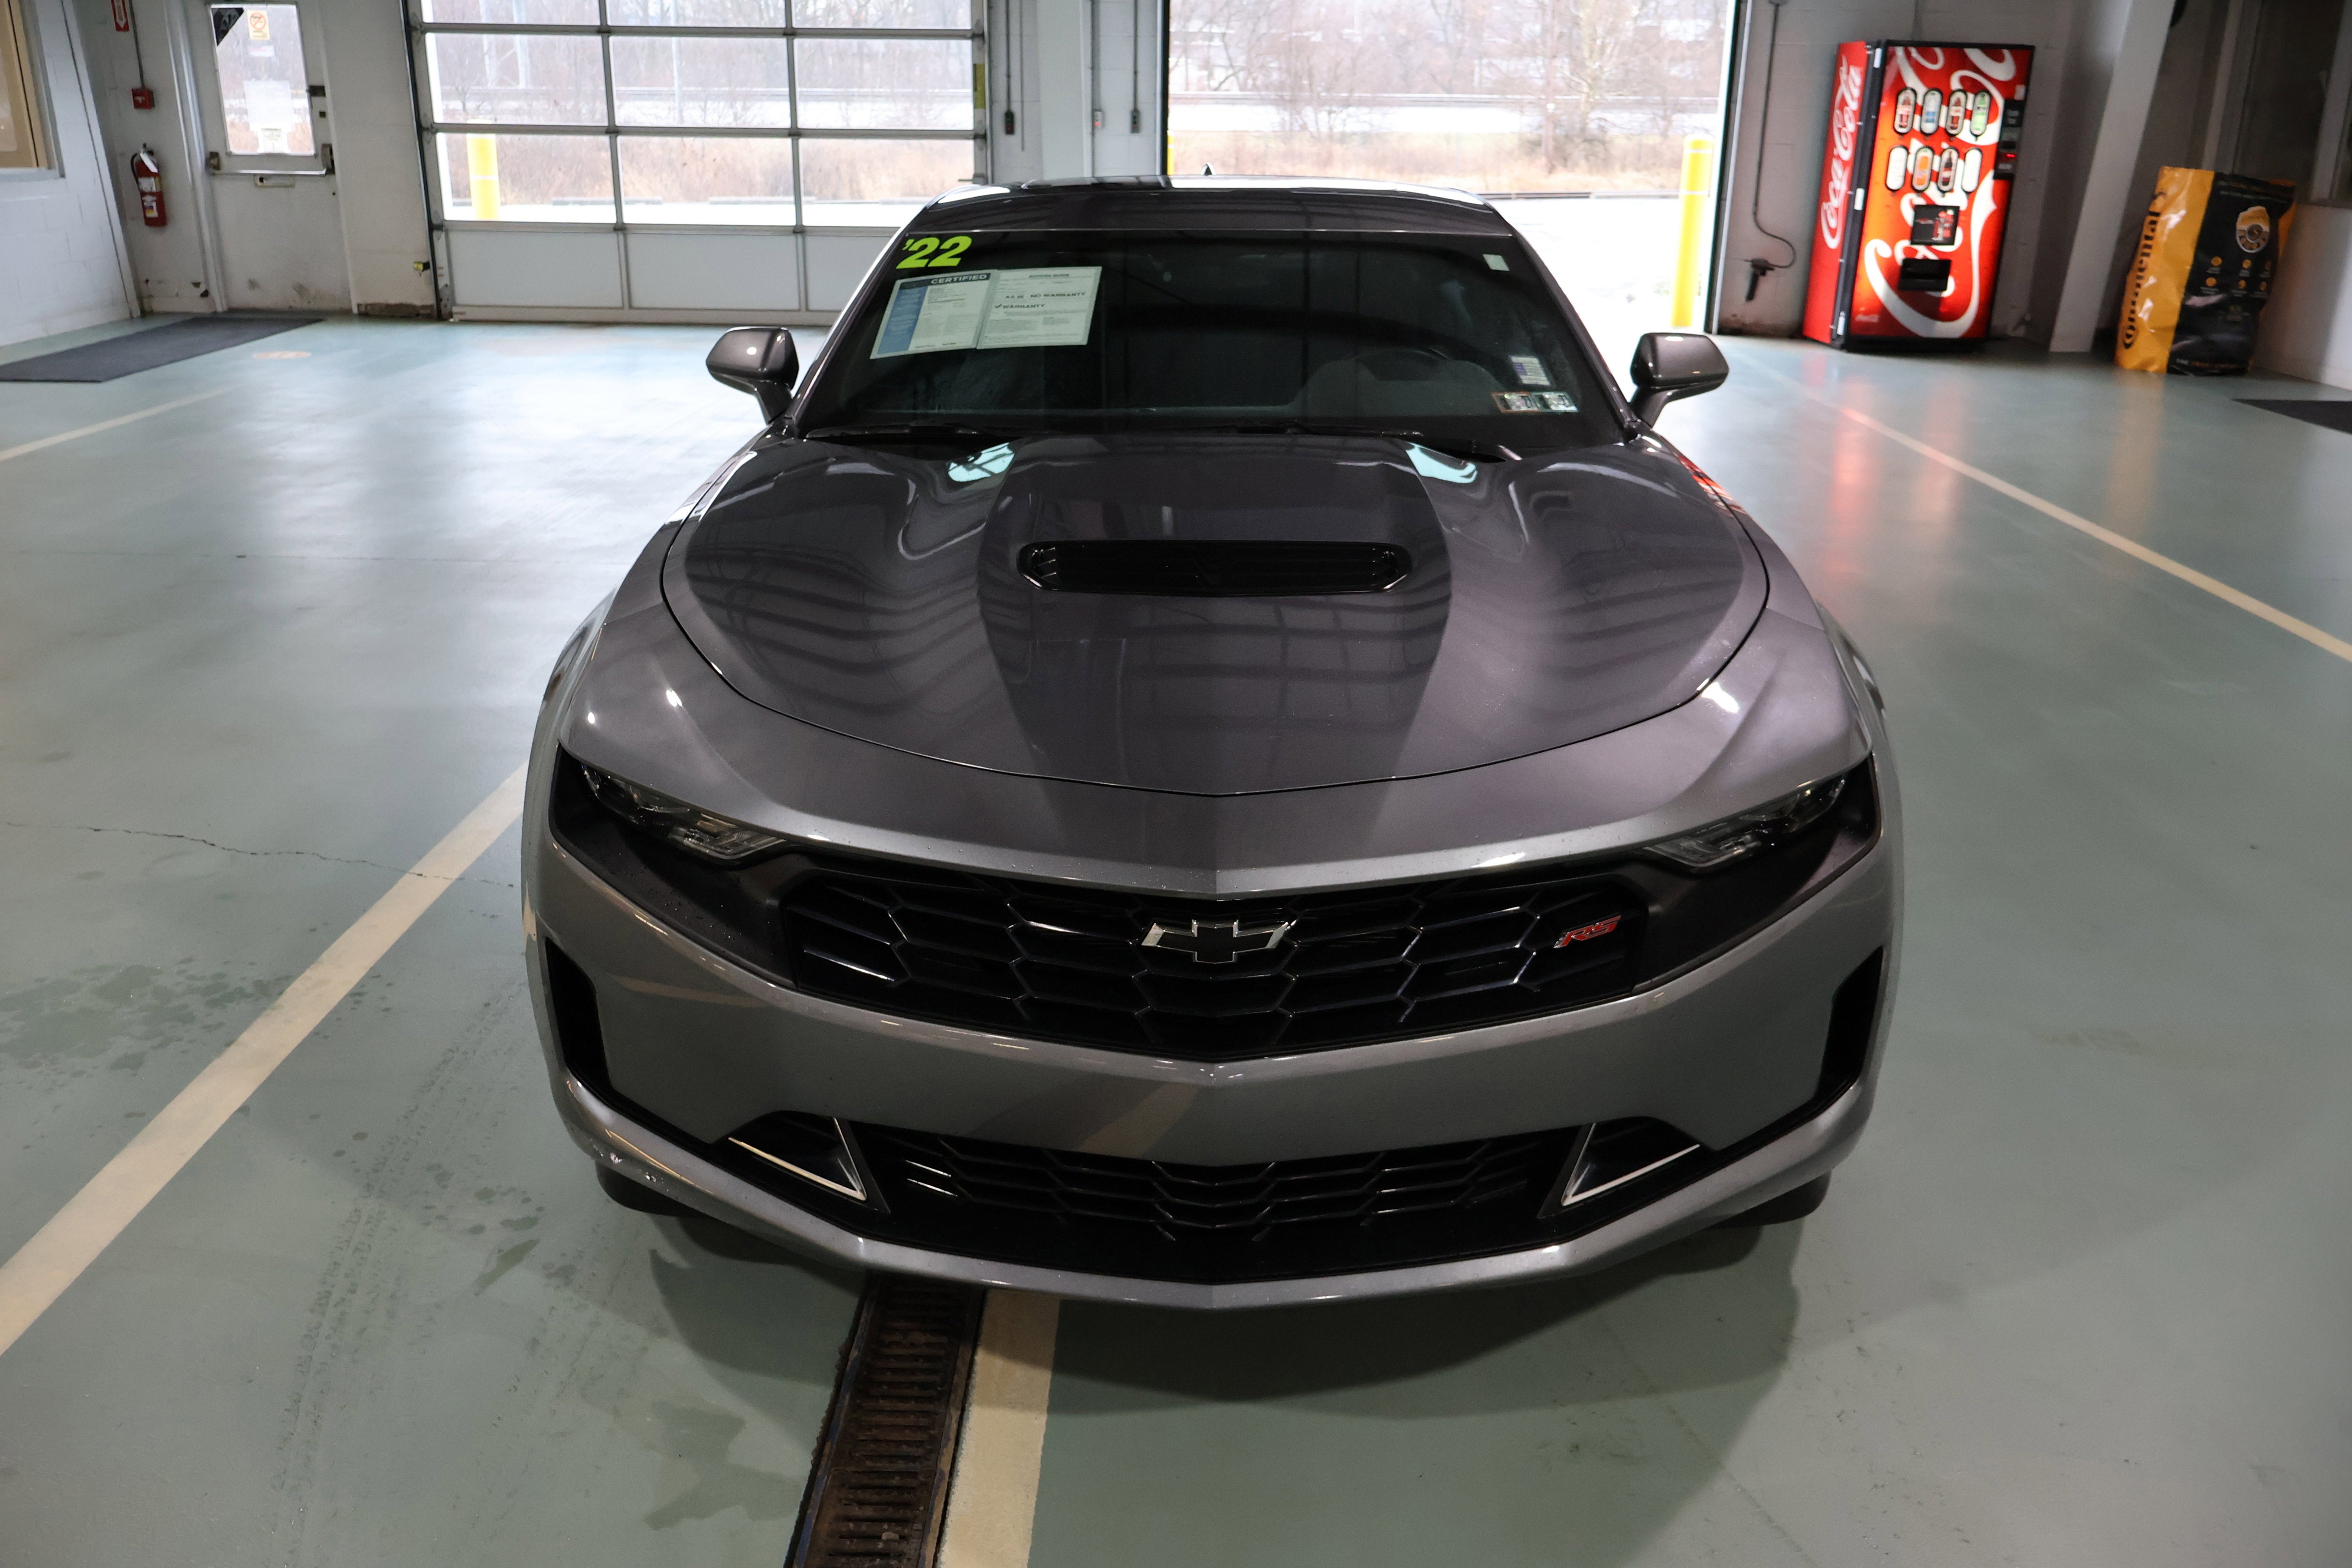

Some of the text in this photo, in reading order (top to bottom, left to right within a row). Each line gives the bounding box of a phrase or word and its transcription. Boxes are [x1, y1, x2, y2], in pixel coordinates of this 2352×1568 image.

[1821, 54, 1862, 249] Coca-Cola
[895, 236, 973, 270] '22
[931, 274, 987, 284] CERTIFIED
[1553, 915, 1621, 949] RS
